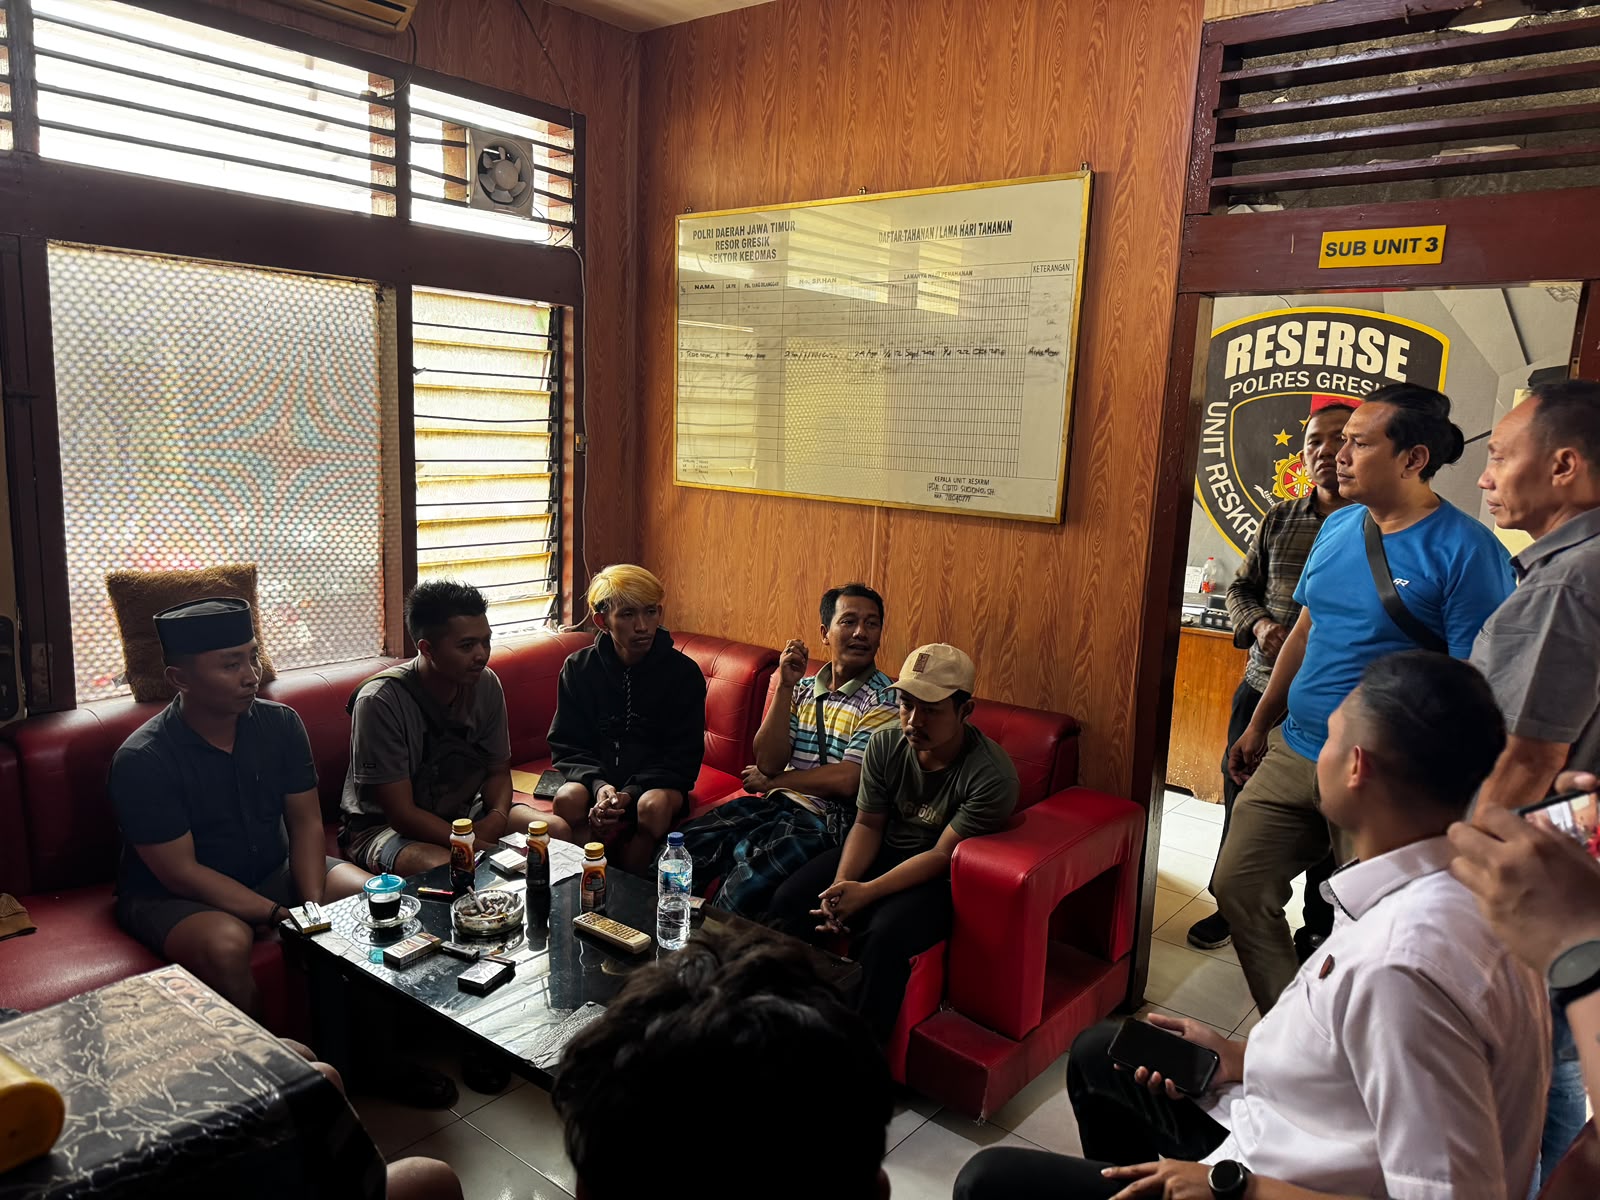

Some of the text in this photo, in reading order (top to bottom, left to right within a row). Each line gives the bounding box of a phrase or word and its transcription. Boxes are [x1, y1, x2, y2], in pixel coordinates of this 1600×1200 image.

[692, 221, 796, 240] POLRI DAERAH JAWA TIMUR
[939, 225, 957, 238] LAMA
[960, 223, 976, 236] HARI
[978, 219, 1013, 235] TAHANAN
[715, 236, 770, 251] RESOR GRESIK
[1325, 236, 1439, 257] SUB UNIT 3
[709, 249, 777, 264] SEKTOR KEBOMAS
[1032, 263, 1071, 274] KETERANGAN
[1224, 320, 1411, 383] RESERSE
[1228, 371, 1310, 400] POLRES
[1203, 401, 1261, 546] UNIT RESKR
